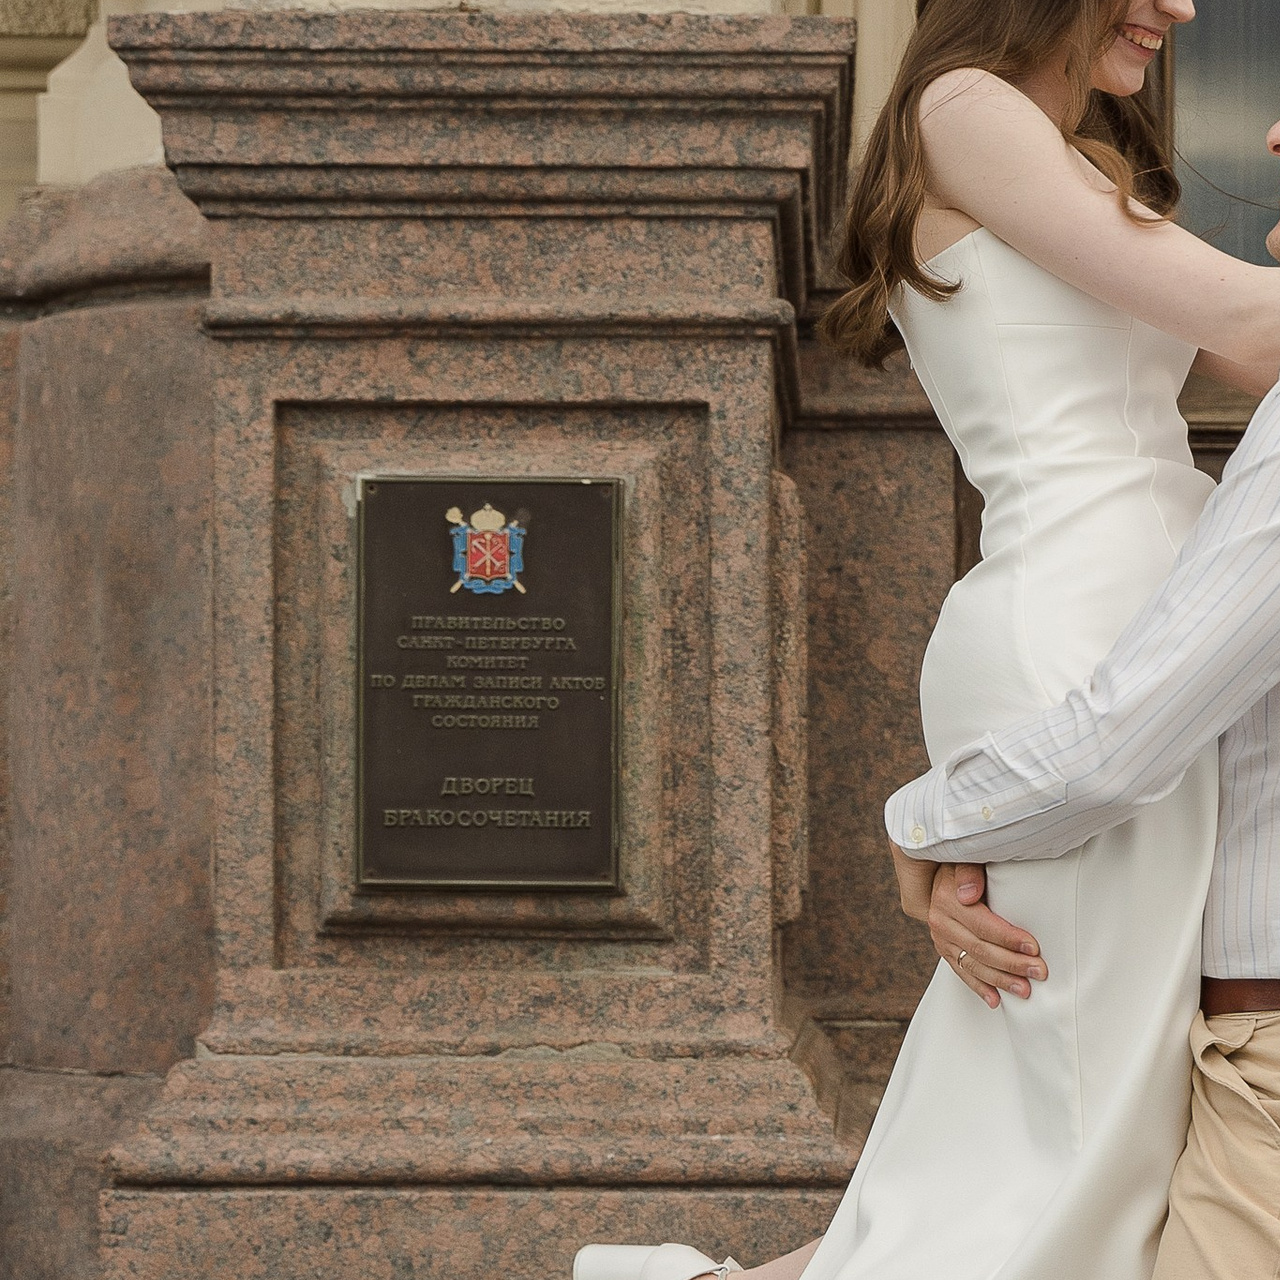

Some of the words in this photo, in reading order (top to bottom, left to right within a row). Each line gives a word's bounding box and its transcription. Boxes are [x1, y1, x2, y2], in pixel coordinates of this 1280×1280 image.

[411, 616, 566, 631] ПРАВИТЕЛЬСТВО
[397, 635, 577, 651] САНКТ-ПЕТЕРБУРГА
[446, 655, 529, 669] КОМИТЕТ
[370, 674, 396, 688] ПО
[402, 674, 467, 689] ДЕЛАМ
[473, 676, 543, 689] ЗАПИСИ
[549, 676, 606, 690] АКТОВ
[412, 694, 559, 709] ГРАЖДАНСКОГО
[432, 715, 540, 728] СОСТОЯНИЯ
[441, 777, 535, 795] ДВОРЕЦ
[383, 809, 592, 827] БРАКОСОЧЕТАНИЯ
